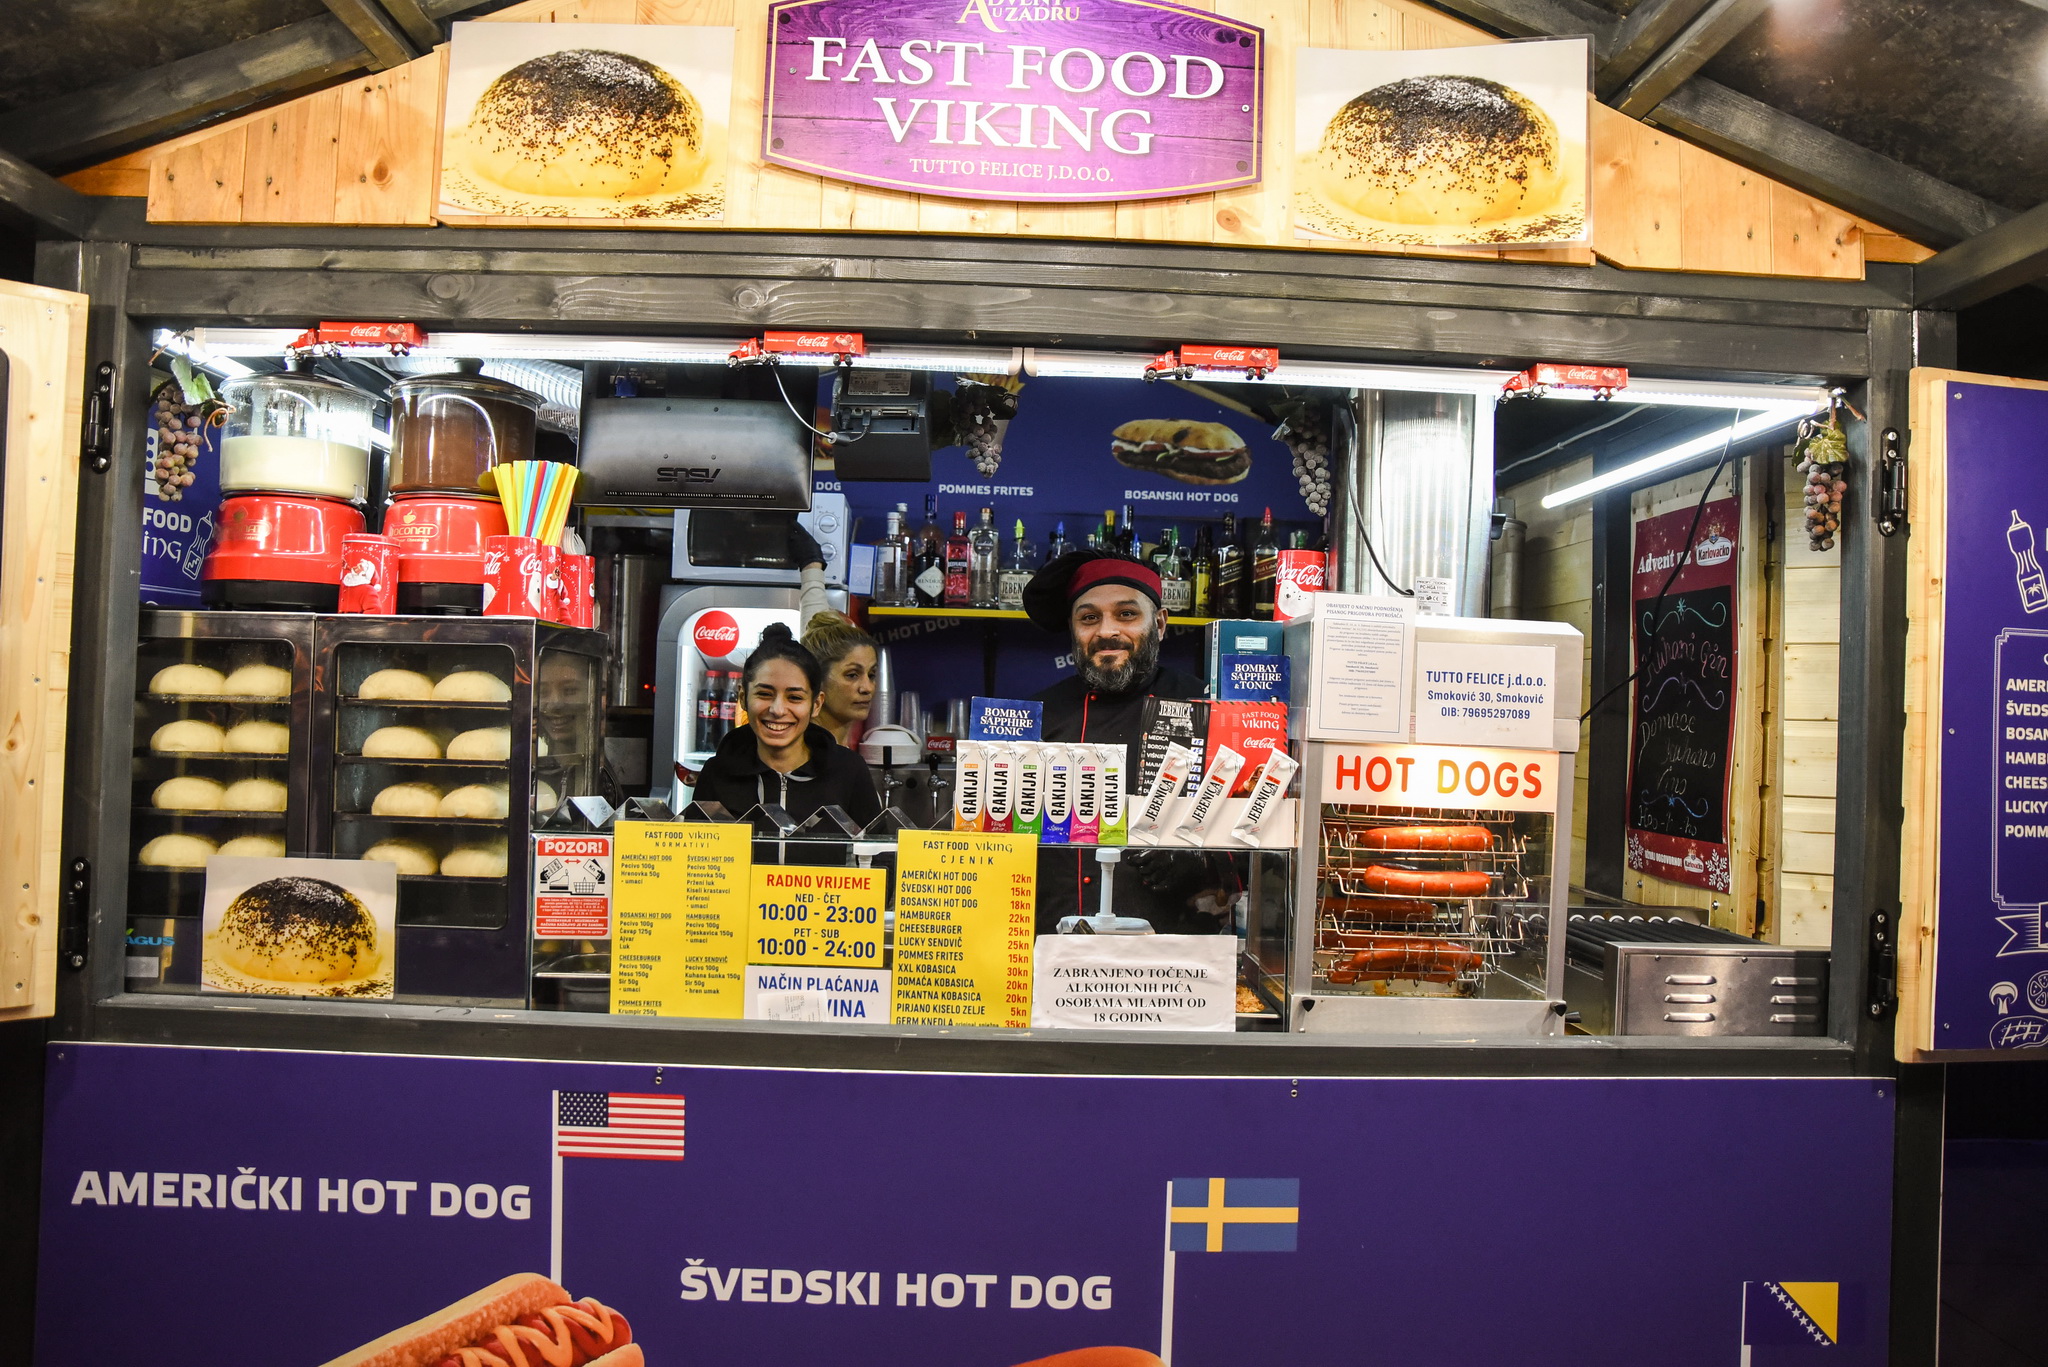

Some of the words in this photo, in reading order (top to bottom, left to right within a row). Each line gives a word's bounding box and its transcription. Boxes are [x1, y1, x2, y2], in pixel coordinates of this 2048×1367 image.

[1004, 7, 1080, 21] ZADRU
[805, 36, 984, 88] FAST
[1006, 43, 1225, 100] FOOD
[872, 97, 1156, 155] VIKING
[910, 158, 976, 176] TUTTO
[979, 161, 1044, 180] FELICE
[1046, 164, 1115, 182] J.D.O.O.
[816, 482, 842, 491] DOG
[939, 484, 990, 496] POMMES
[993, 485, 1033, 496] FRITES
[1124, 490, 1184, 501] BOSANSKI
[1186, 491, 1208, 502] HOT
[1210, 492, 1239, 503] DOG
[143, 507, 192, 533] FOOD
[1637, 550, 1676, 574] Advent
[1235, 664, 1278, 672] BOMBAY
[1231, 672, 1282, 681] SAPPHIRE
[1426, 671, 1463, 684] TUTTO
[1467, 673, 1504, 685] FELICE
[1507, 674, 1546, 688] j.d.o.o.
[1240, 681, 1273, 690] TONIC
[1428, 690, 1476, 701] Smoković
[1479, 692, 1493, 703] 30,
[1496, 693, 1544, 704] Smoković
[985, 708, 1030, 718] BOMBAY
[1441, 707, 1460, 717] OIB:
[1462, 708, 1530, 719] 79695297089
[980, 716, 1033, 728] SAPPHIRE
[989, 726, 1023, 736] TONIC
[1336, 754, 1415, 792] HOT
[1437, 759, 1542, 799] DOGS
[963, 771, 978, 813] RAKIJA
[992, 771, 1008, 813] RAKIJA
[1021, 772, 1036, 815] RAKIJA
[1051, 773, 1066, 816] RAKIJA
[1080, 773, 1095, 816] RAKIJA
[1105, 775, 1118, 818] RAKIJA
[1146, 780, 1173, 822] JEBENICA
[1192, 782, 1220, 823] JEBENICA
[1248, 782, 1276, 824] JEBENICA
[2005, 800, 2048, 814] LUCKY
[545, 841, 603, 853] POZOR!
[923, 841, 944, 850] FAST
[947, 842, 969, 850] FOOD
[767, 874, 811, 888] RADNO
[816, 876, 871, 890] VRIJEME
[902, 869, 940, 880] AMERIČKI
[944, 872, 959, 881] HOT
[962, 873, 978, 881] DOG
[1012, 874, 1032, 883] 12kn
[901, 881, 935, 893] ŠVEDSKI
[937, 885, 954, 894] HOT
[956, 886, 971, 894] DOG
[1011, 887, 1031, 897] 15kn
[795, 894, 813, 903] NED
[824, 892, 841, 904] ČET
[901, 897, 941, 907] BOSANSKI
[944, 898, 959, 907] HOT
[962, 899, 978, 908] DOG
[1010, 901, 1030, 910] 18kn
[758, 904, 807, 921] 10:00
[826, 906, 877, 924] 23:00
[900, 910, 951, 920] HAMBURGER
[1009, 914, 1030, 923] 22kn
[794, 928, 811, 937] PET
[821, 929, 839, 938] SUB
[900, 924, 962, 934] CHEESEBURGER
[1008, 927, 1030, 936] 25kn
[757, 938, 806, 956] 10:00
[825, 940, 875, 958] 24:00
[899, 937, 926, 946] LUCKY
[928, 937, 962, 947] SENDVIČ
[1008, 941, 1029, 950] 25kn
[899, 950, 933, 959] POMMES
[936, 951, 964, 960] FRITES
[1008, 954, 1028, 963] 15kn
[898, 963, 913, 972] XXL
[916, 964, 956, 974] KOBASICA
[1007, 967, 1028, 976] 30kn
[1053, 967, 1143, 978] ZABRANJENO
[1147, 967, 1208, 979] TOČENJE
[758, 973, 802, 990] NAČIN
[807, 975, 879, 993] PLAĆANJA
[898, 975, 932, 986] DOMAĆA
[934, 978, 974, 988] KOBASICA
[1006, 981, 1028, 990] 20kn
[1066, 983, 1158, 993] ALKOHOLNIH
[1161, 981, 1192, 994] PIĆA
[897, 990, 938, 1000] PIKANTNA
[942, 991, 981, 1001] KOBASICA
[1006, 994, 1027, 1003] 20kn
[1055, 998, 1122, 1008] OSOBAMA
[1127, 998, 1183, 1008] MLAĐIM
[1187, 998, 1206, 1008] OD
[897, 1003, 930, 1013] PIRJANO
[933, 1004, 960, 1014] KISELO
[963, 1006, 985, 1015] ZELJE
[1010, 1007, 1026, 1016] 5kn
[1094, 1013, 1106, 1022] 18
[1109, 1013, 1162, 1023] GODINA
[71, 1166, 303, 1212] AMERIČKI
[317, 1177, 418, 1215] HOT
[430, 1182, 532, 1220] DOG
[679, 1257, 880, 1306] ŠVEDSKI
[896, 1272, 997, 1309] HOT
[1010, 1274, 1113, 1311] DOG
